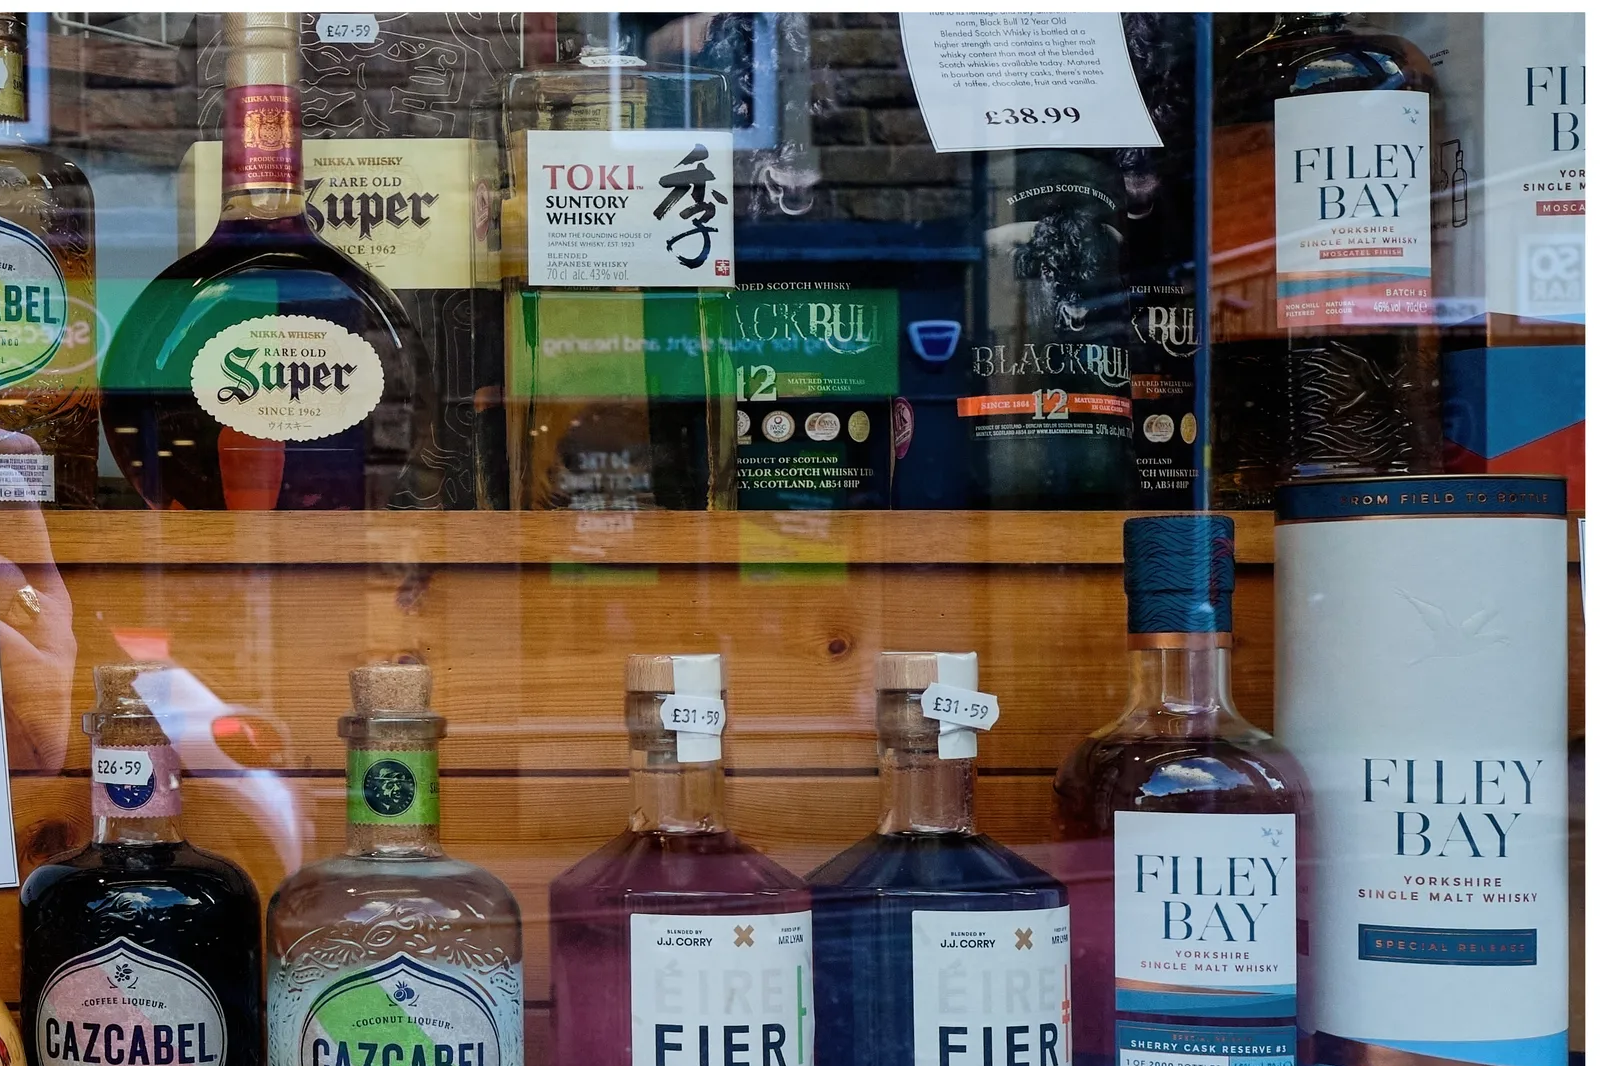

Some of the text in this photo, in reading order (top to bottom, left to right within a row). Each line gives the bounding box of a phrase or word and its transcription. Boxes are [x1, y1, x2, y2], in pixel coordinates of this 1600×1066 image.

[985, 106, 1080, 124] £38.99
[1294, 144, 1424, 183] FILEY
[546, 196, 629, 209] SUNTORY
[653, 143, 728, 269] 季
[1318, 184, 1409, 220] BAY
[547, 212, 616, 225] WHISKY
[250, 331, 327, 340] NIKKA WHISKY
[264, 348, 326, 357] RARE OLD
[218, 347, 358, 404] Super
[258, 407, 321, 416] SINCE 1962
[1032, 389, 1068, 420] 12
[819, 480, 841, 488] AB54
[844, 480, 859, 488] 8HP
[1135, 854, 1288, 896] FILEY
[1162, 901, 1268, 942] BAY
[657, 937, 712, 946] J.J. CORRY
[46, 1017, 214, 1066] CAZCABEL
[1131, 1040, 1179, 1050] SHERRY
[1184, 1044, 1216, 1052] CASK
[1223, 1045, 1271, 1053] RESERVE
